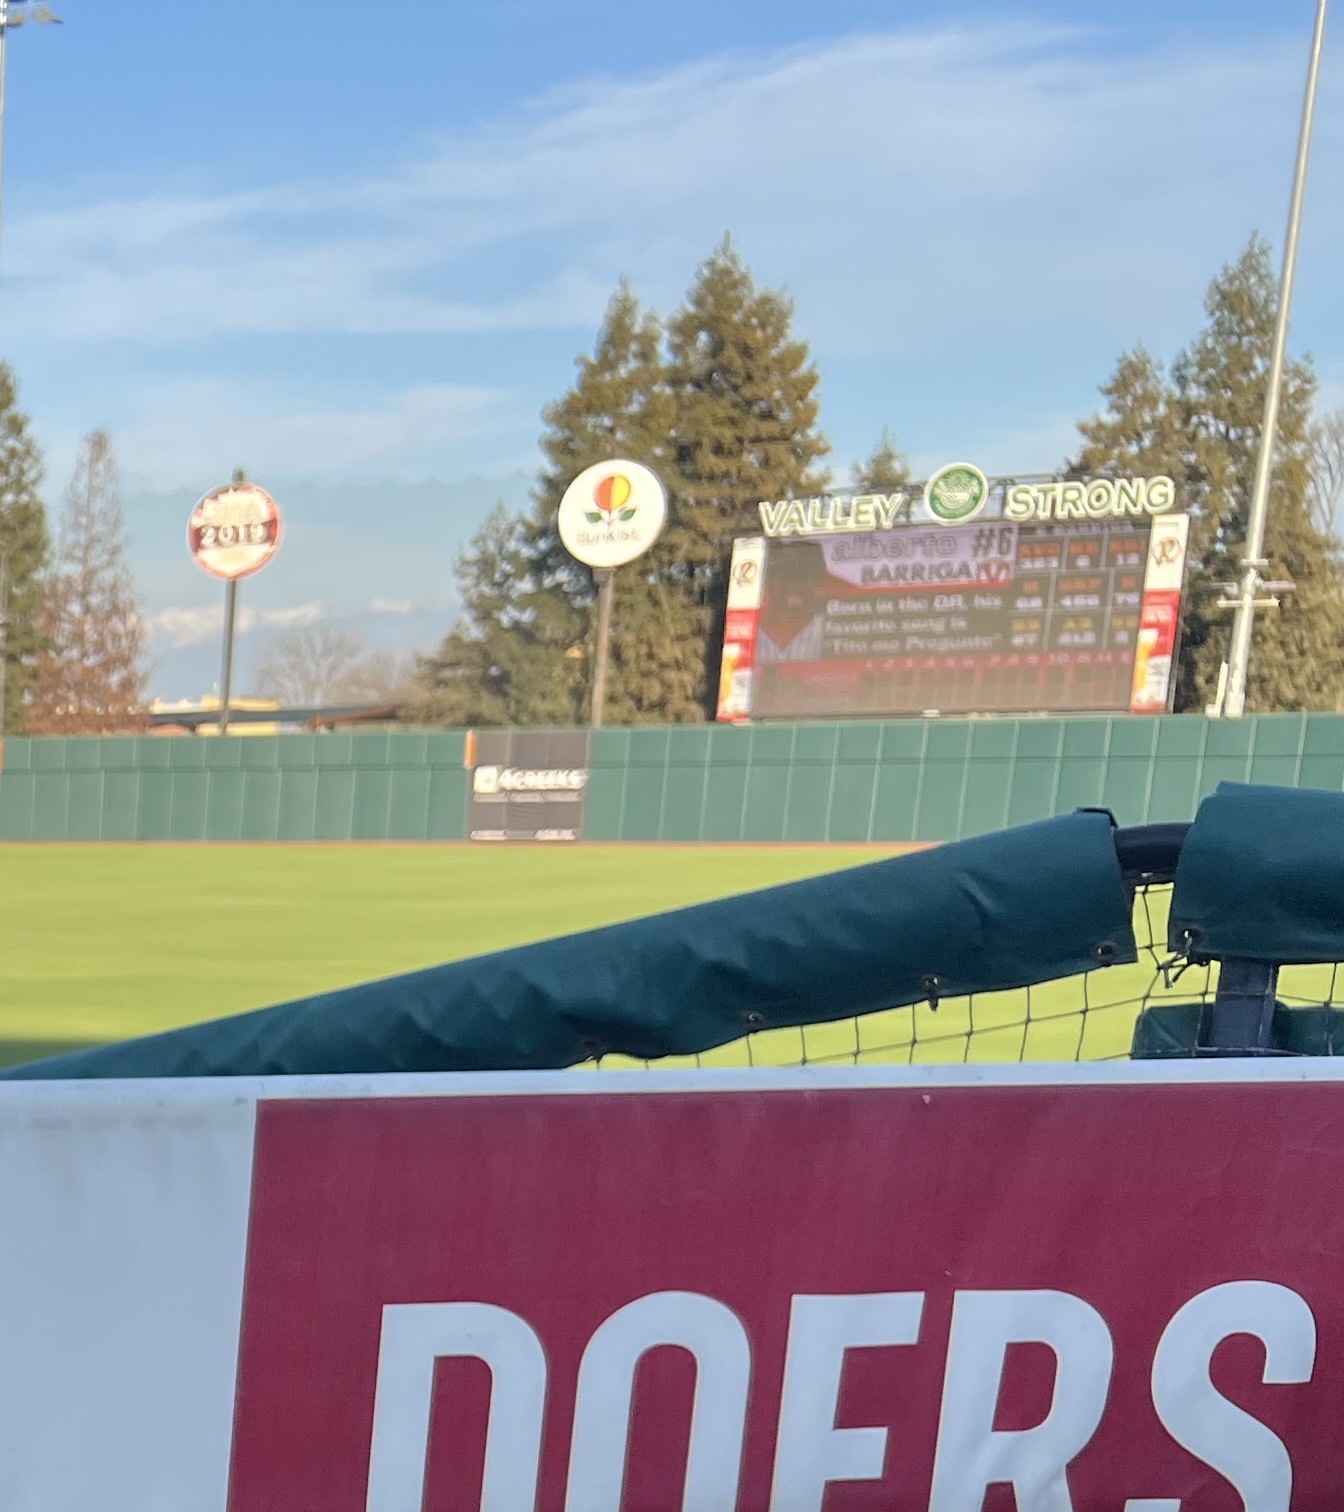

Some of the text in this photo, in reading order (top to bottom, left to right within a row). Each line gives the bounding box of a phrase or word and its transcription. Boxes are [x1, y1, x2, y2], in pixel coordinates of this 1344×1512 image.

[759, 476, 1176, 536] VALLEY STRONG
[200, 522, 269, 548] 2019
